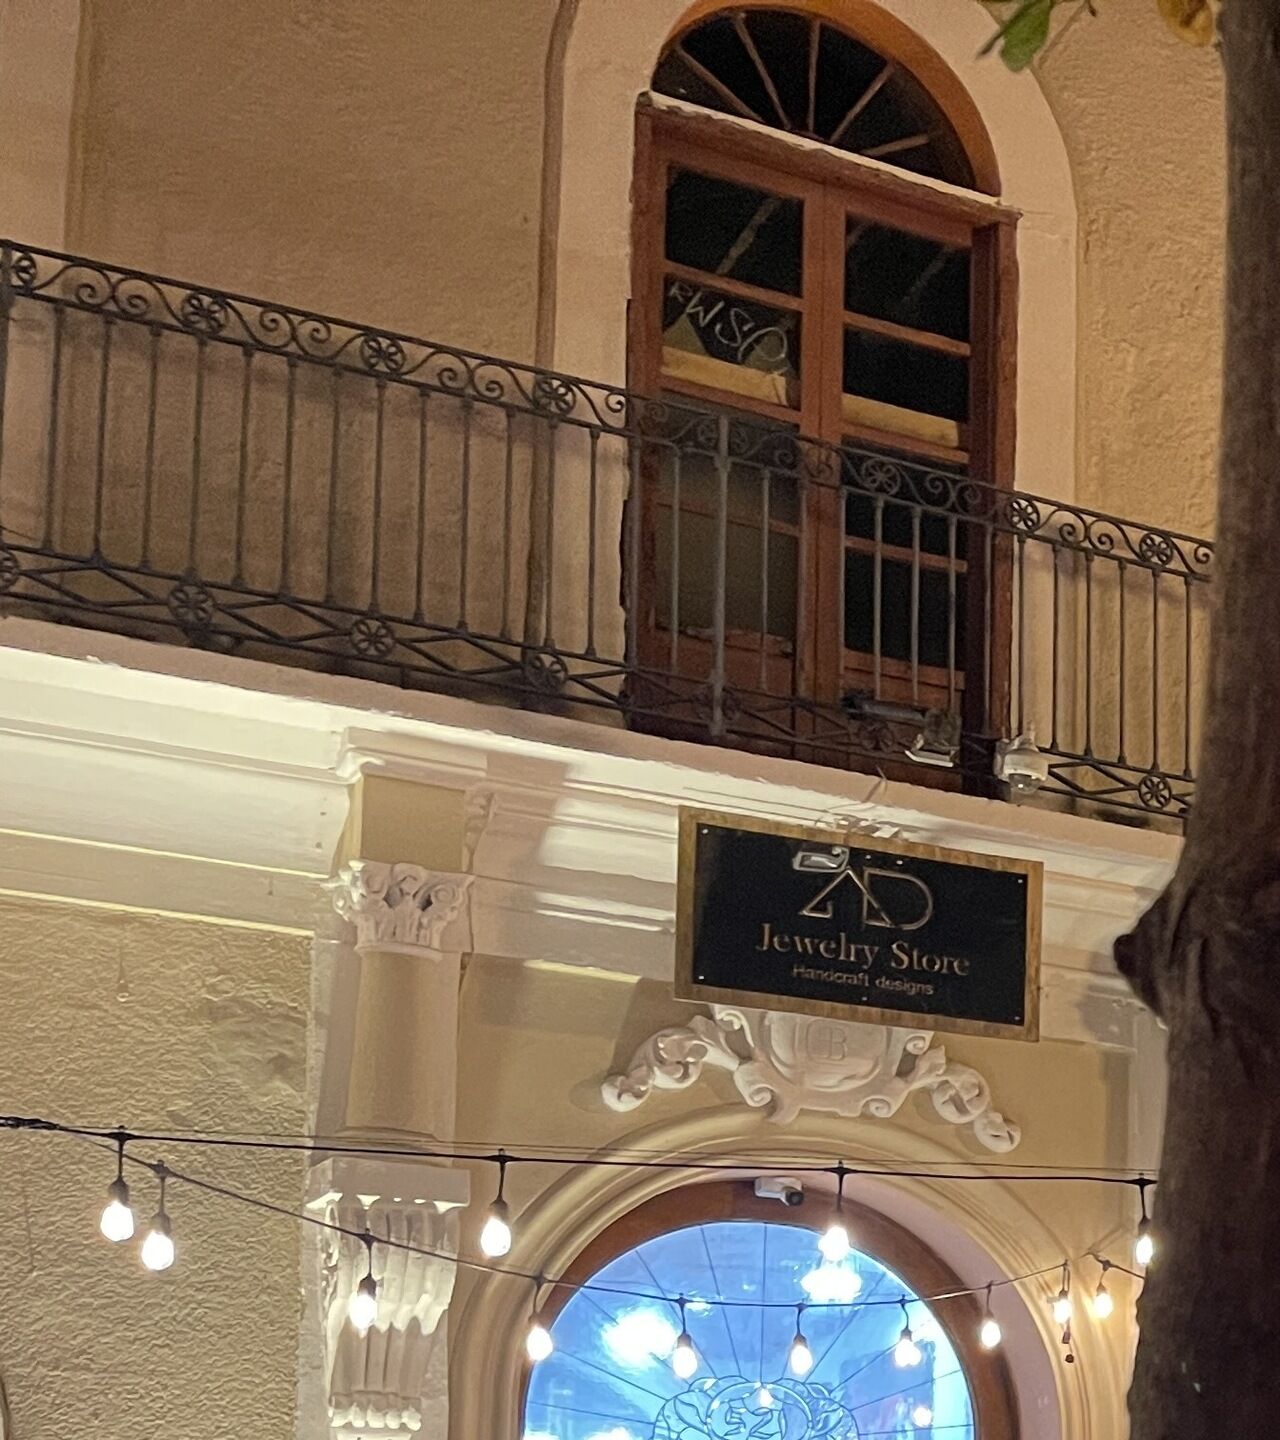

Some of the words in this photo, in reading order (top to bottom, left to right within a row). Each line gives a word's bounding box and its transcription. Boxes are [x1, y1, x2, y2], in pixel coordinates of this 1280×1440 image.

[755, 923, 879, 970] Jewelry
[890, 940, 970, 976] Store
[791, 963, 870, 988] Handcraft
[875, 975, 934, 997] designs
